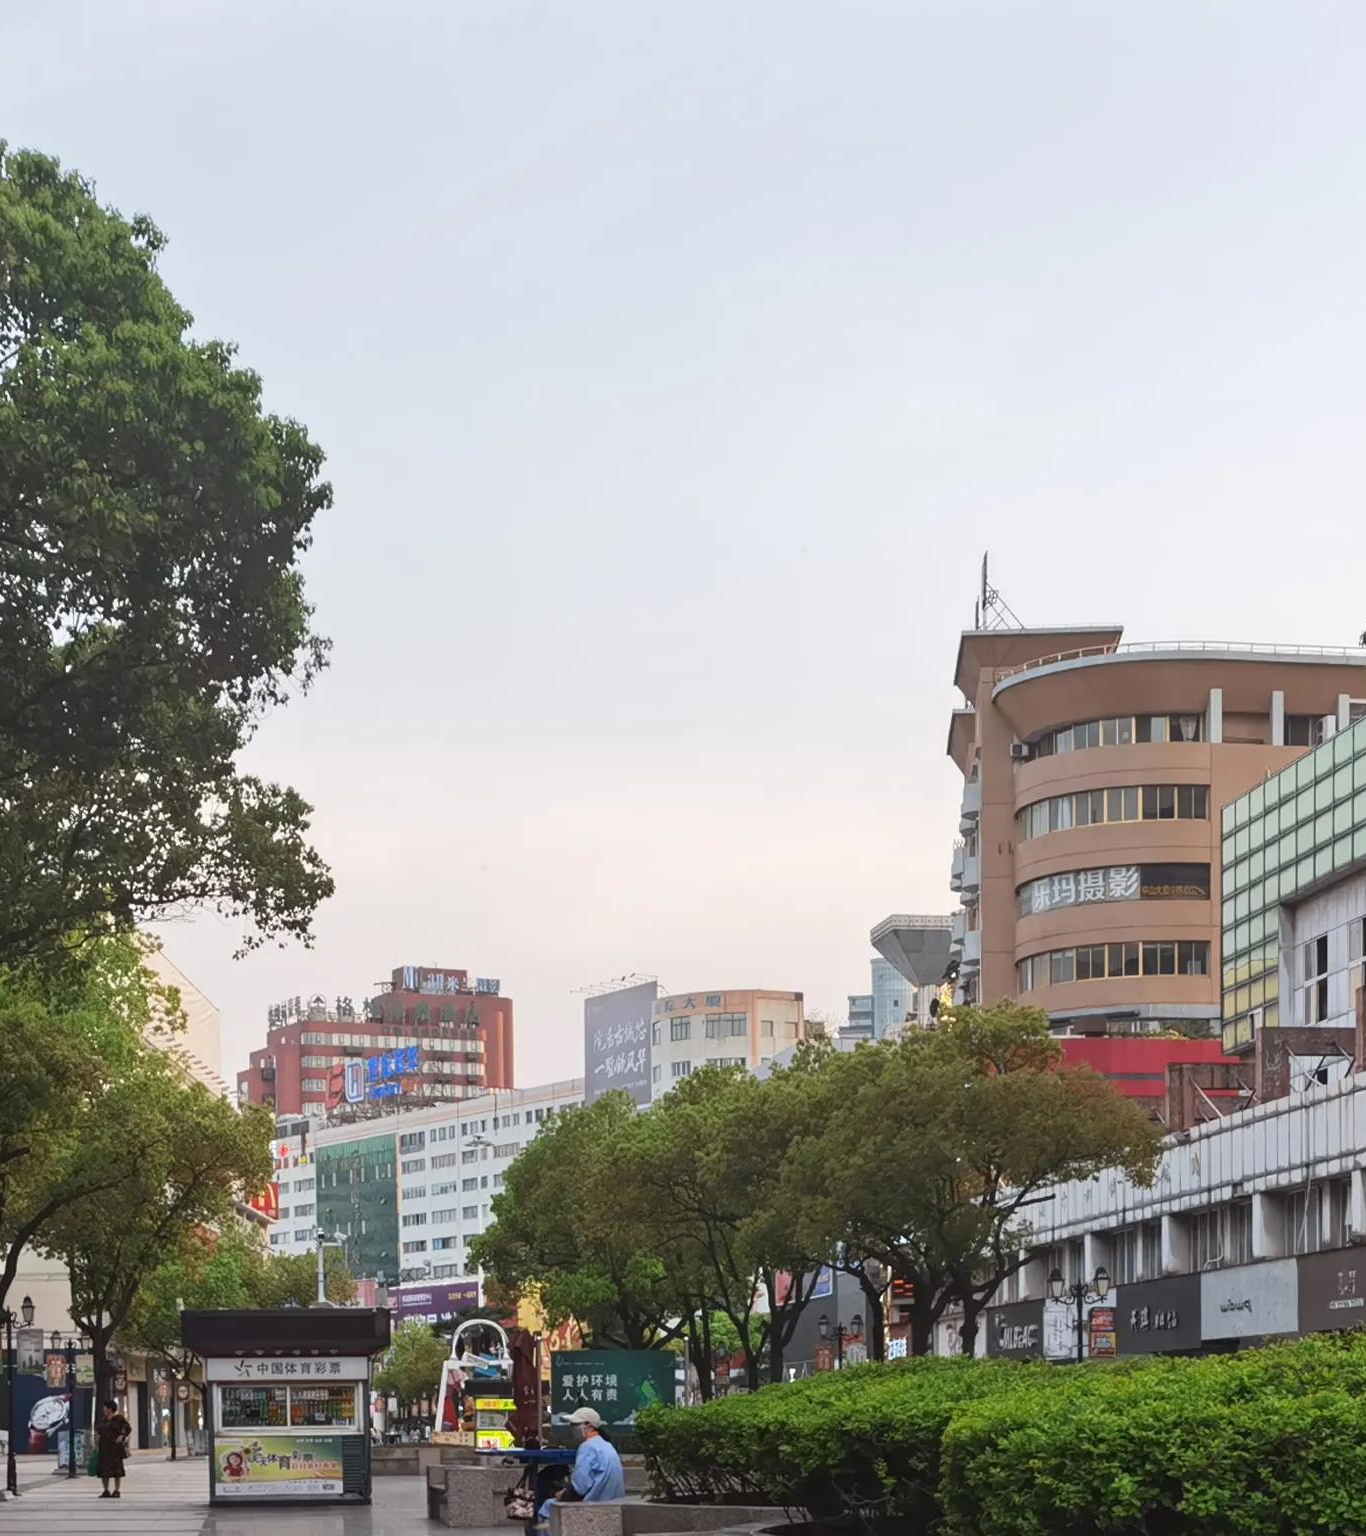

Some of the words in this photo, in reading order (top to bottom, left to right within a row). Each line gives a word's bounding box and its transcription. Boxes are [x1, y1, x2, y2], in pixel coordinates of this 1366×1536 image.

[257, 1361, 341, 1375] 中国体育彩票
[562, 1374, 618, 1387] 爱护环境
[562, 1388, 618, 1402] 人人有责
